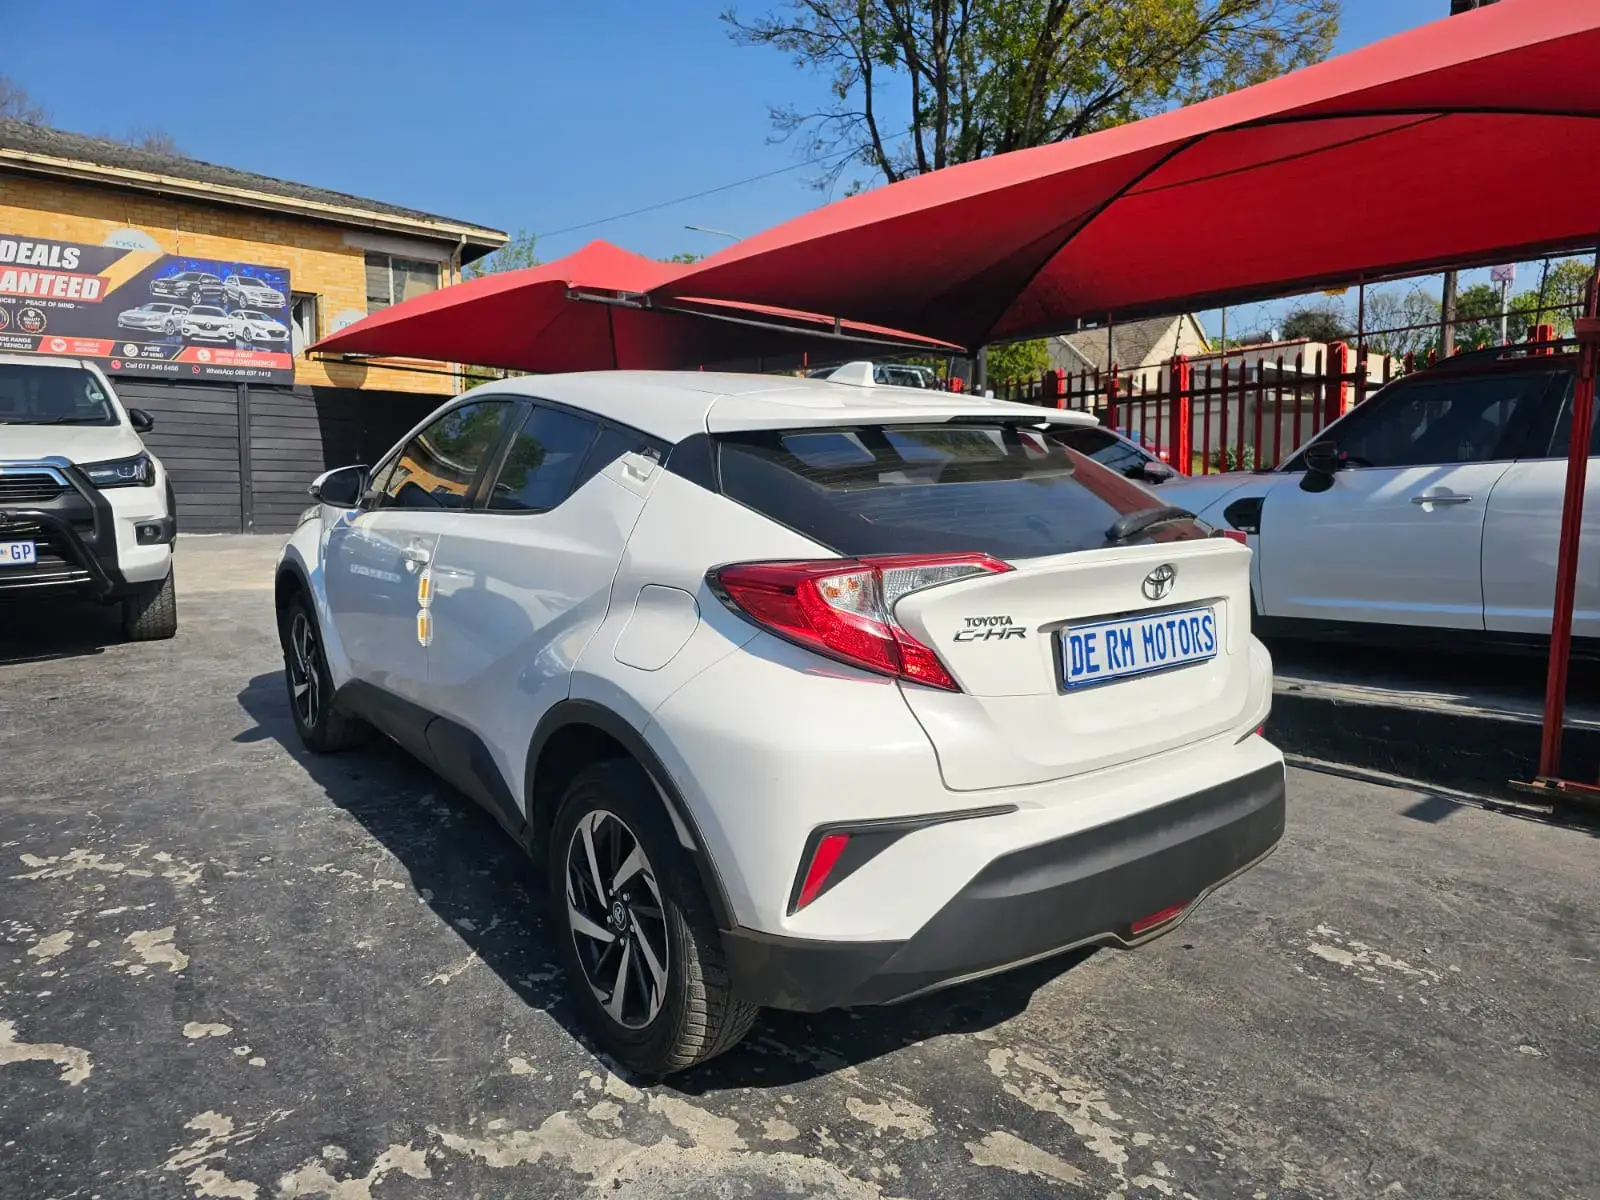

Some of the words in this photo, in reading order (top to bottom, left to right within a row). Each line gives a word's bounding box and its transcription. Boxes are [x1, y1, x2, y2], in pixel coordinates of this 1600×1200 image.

[0, 240, 80, 269] DEALS
[0, 270, 100, 299] ANTEED
[206, 367, 235, 376] WhatsApp
[11, 544, 31, 560] GP
[964, 615, 1013, 628] TOYOTA
[953, 628, 1026, 642] C-HR
[1070, 633, 1100, 676] DE
[1105, 627, 1135, 670] RM
[1142, 615, 1214, 663] MOTORS
